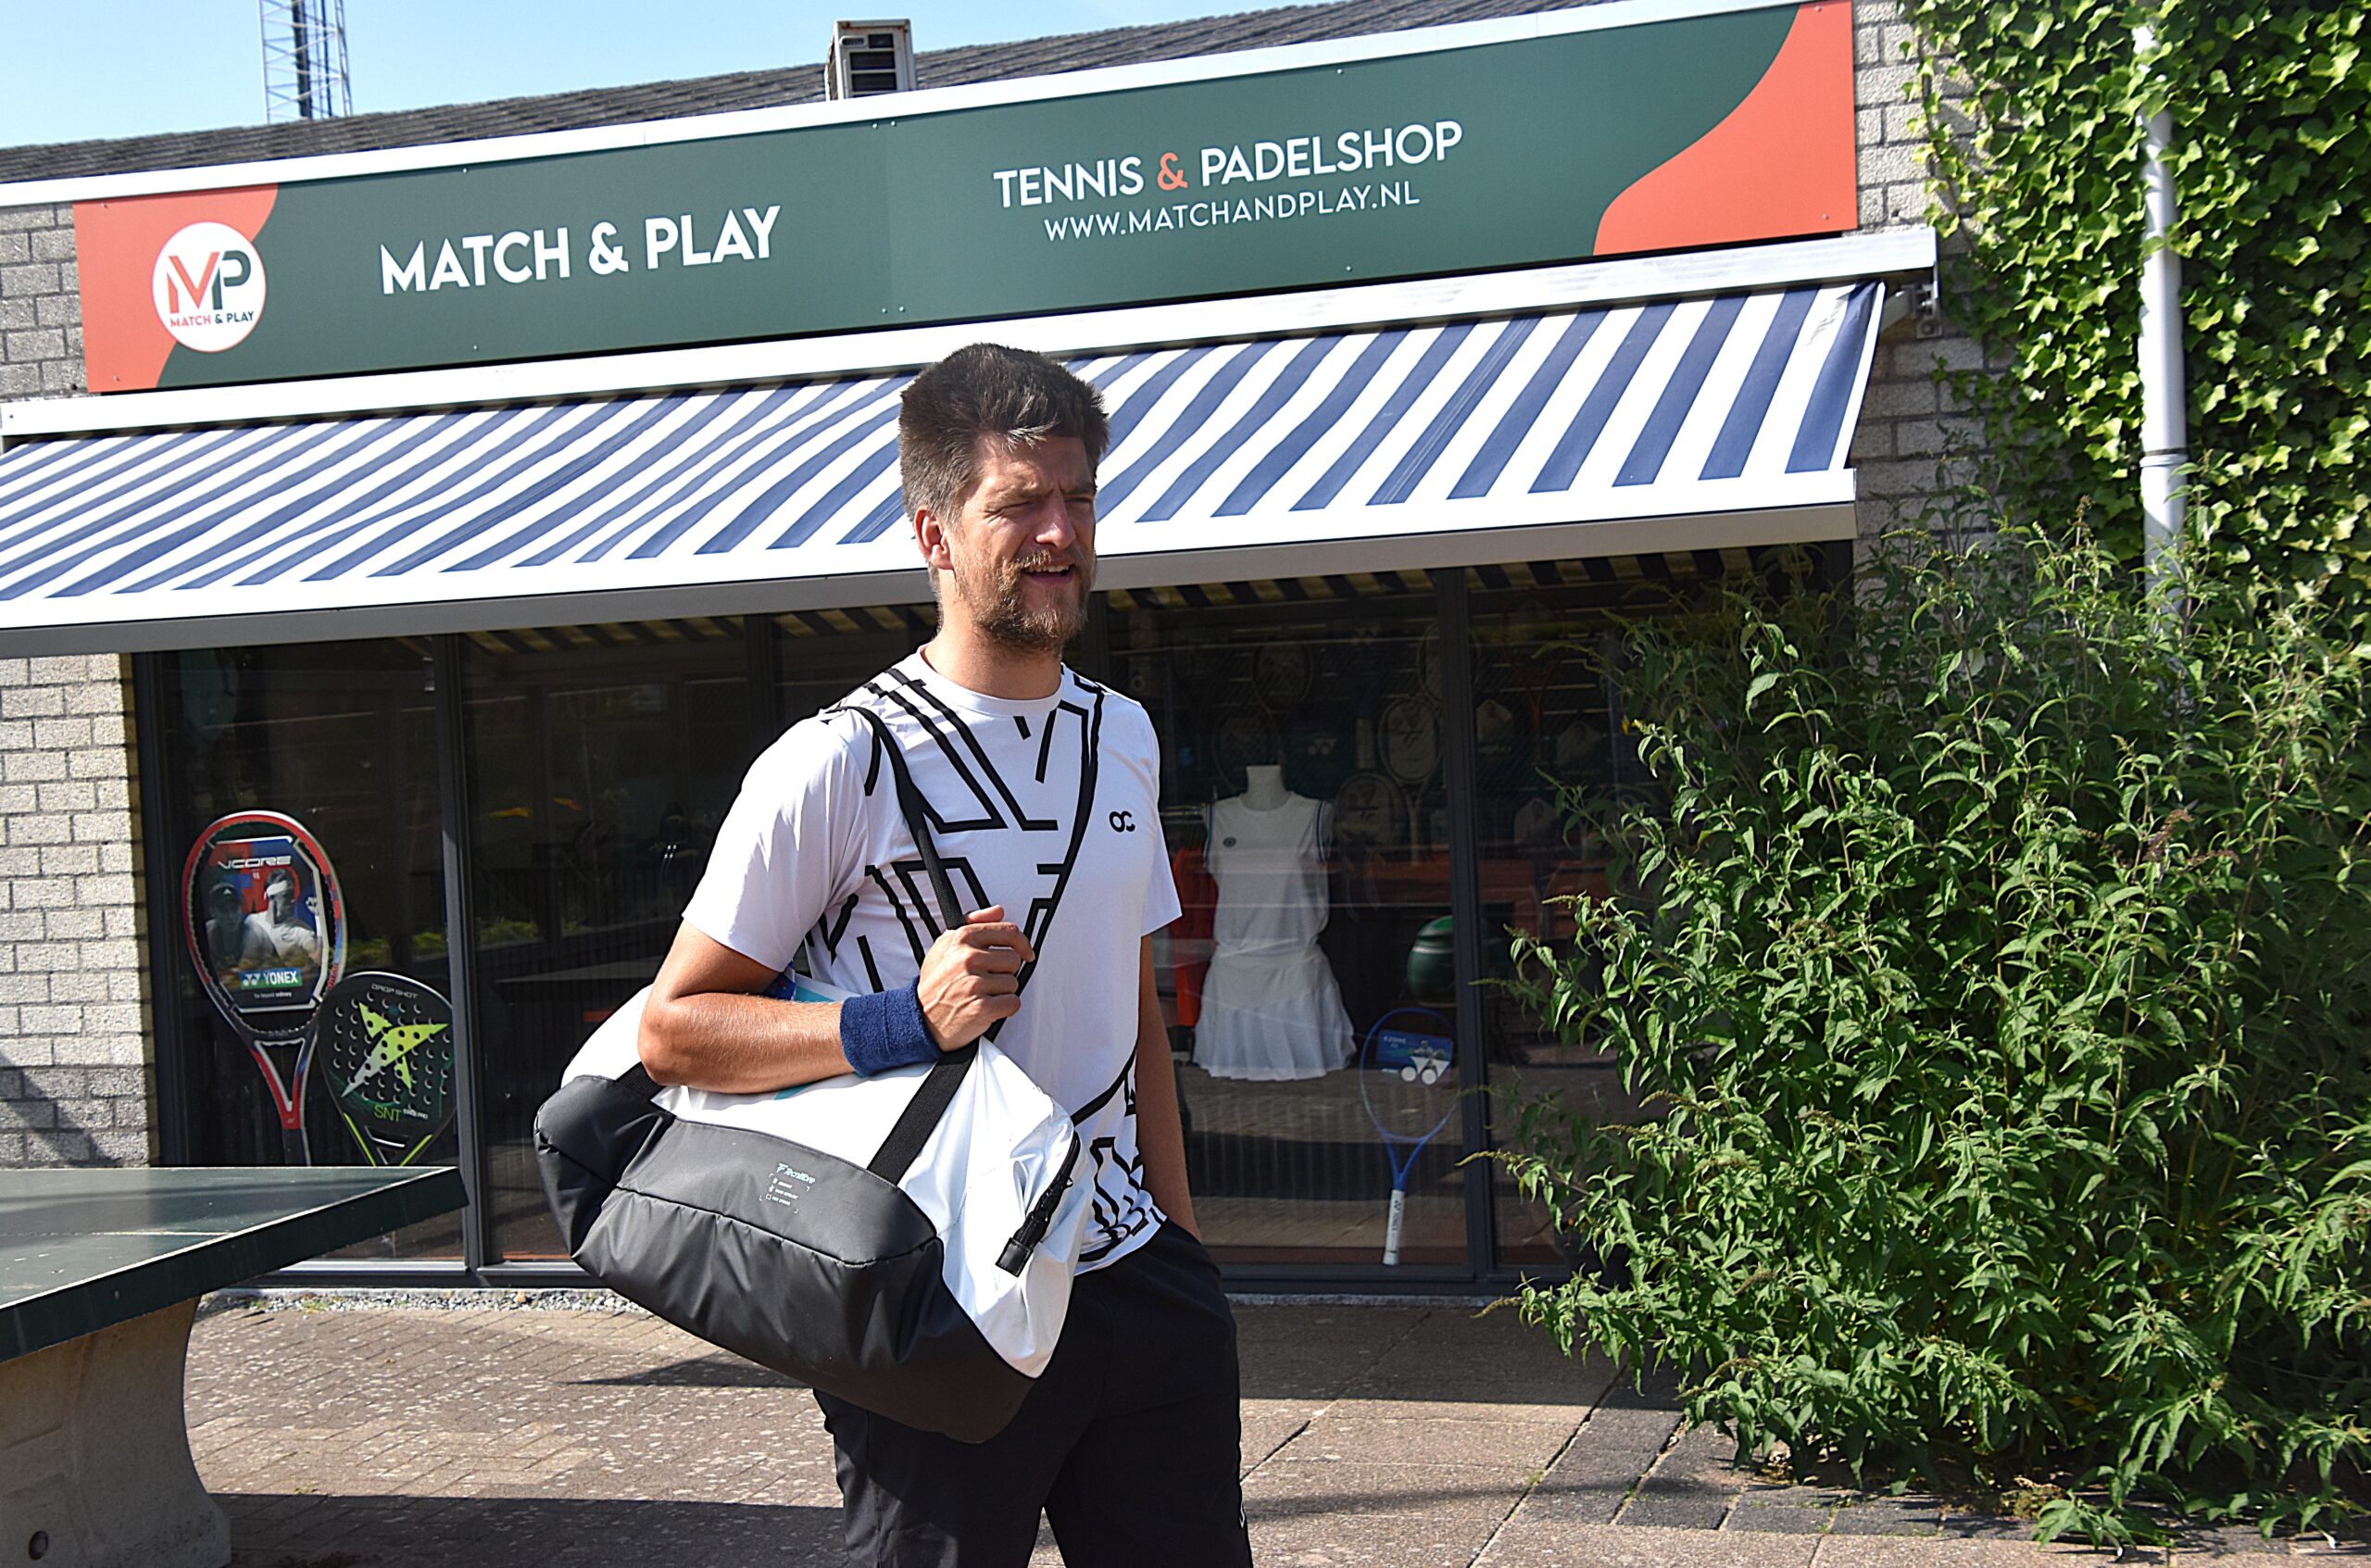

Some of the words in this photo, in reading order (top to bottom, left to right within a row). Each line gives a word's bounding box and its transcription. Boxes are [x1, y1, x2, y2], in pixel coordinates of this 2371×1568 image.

[993, 155, 1145, 208] TENNIS
[1157, 152, 1189, 192] &
[1200, 119, 1463, 187] PADELSHOP
[1043, 181, 1421, 242] WWW.MATCHANDPLAY.NL
[381, 226, 571, 295] MATCH
[588, 221, 631, 276] &
[645, 205, 782, 270] PLAY
[167, 250, 252, 313] MP
[169, 314, 211, 328] MATCH
[214, 313, 223, 325] &
[226, 310, 255, 324] PLAY
[217, 854, 293, 871] VCORE
[263, 971, 298, 985] YONEX
[371, 983, 395, 994] DROP
[395, 988, 419, 999] SHOT
[374, 1104, 402, 1123] SNT
